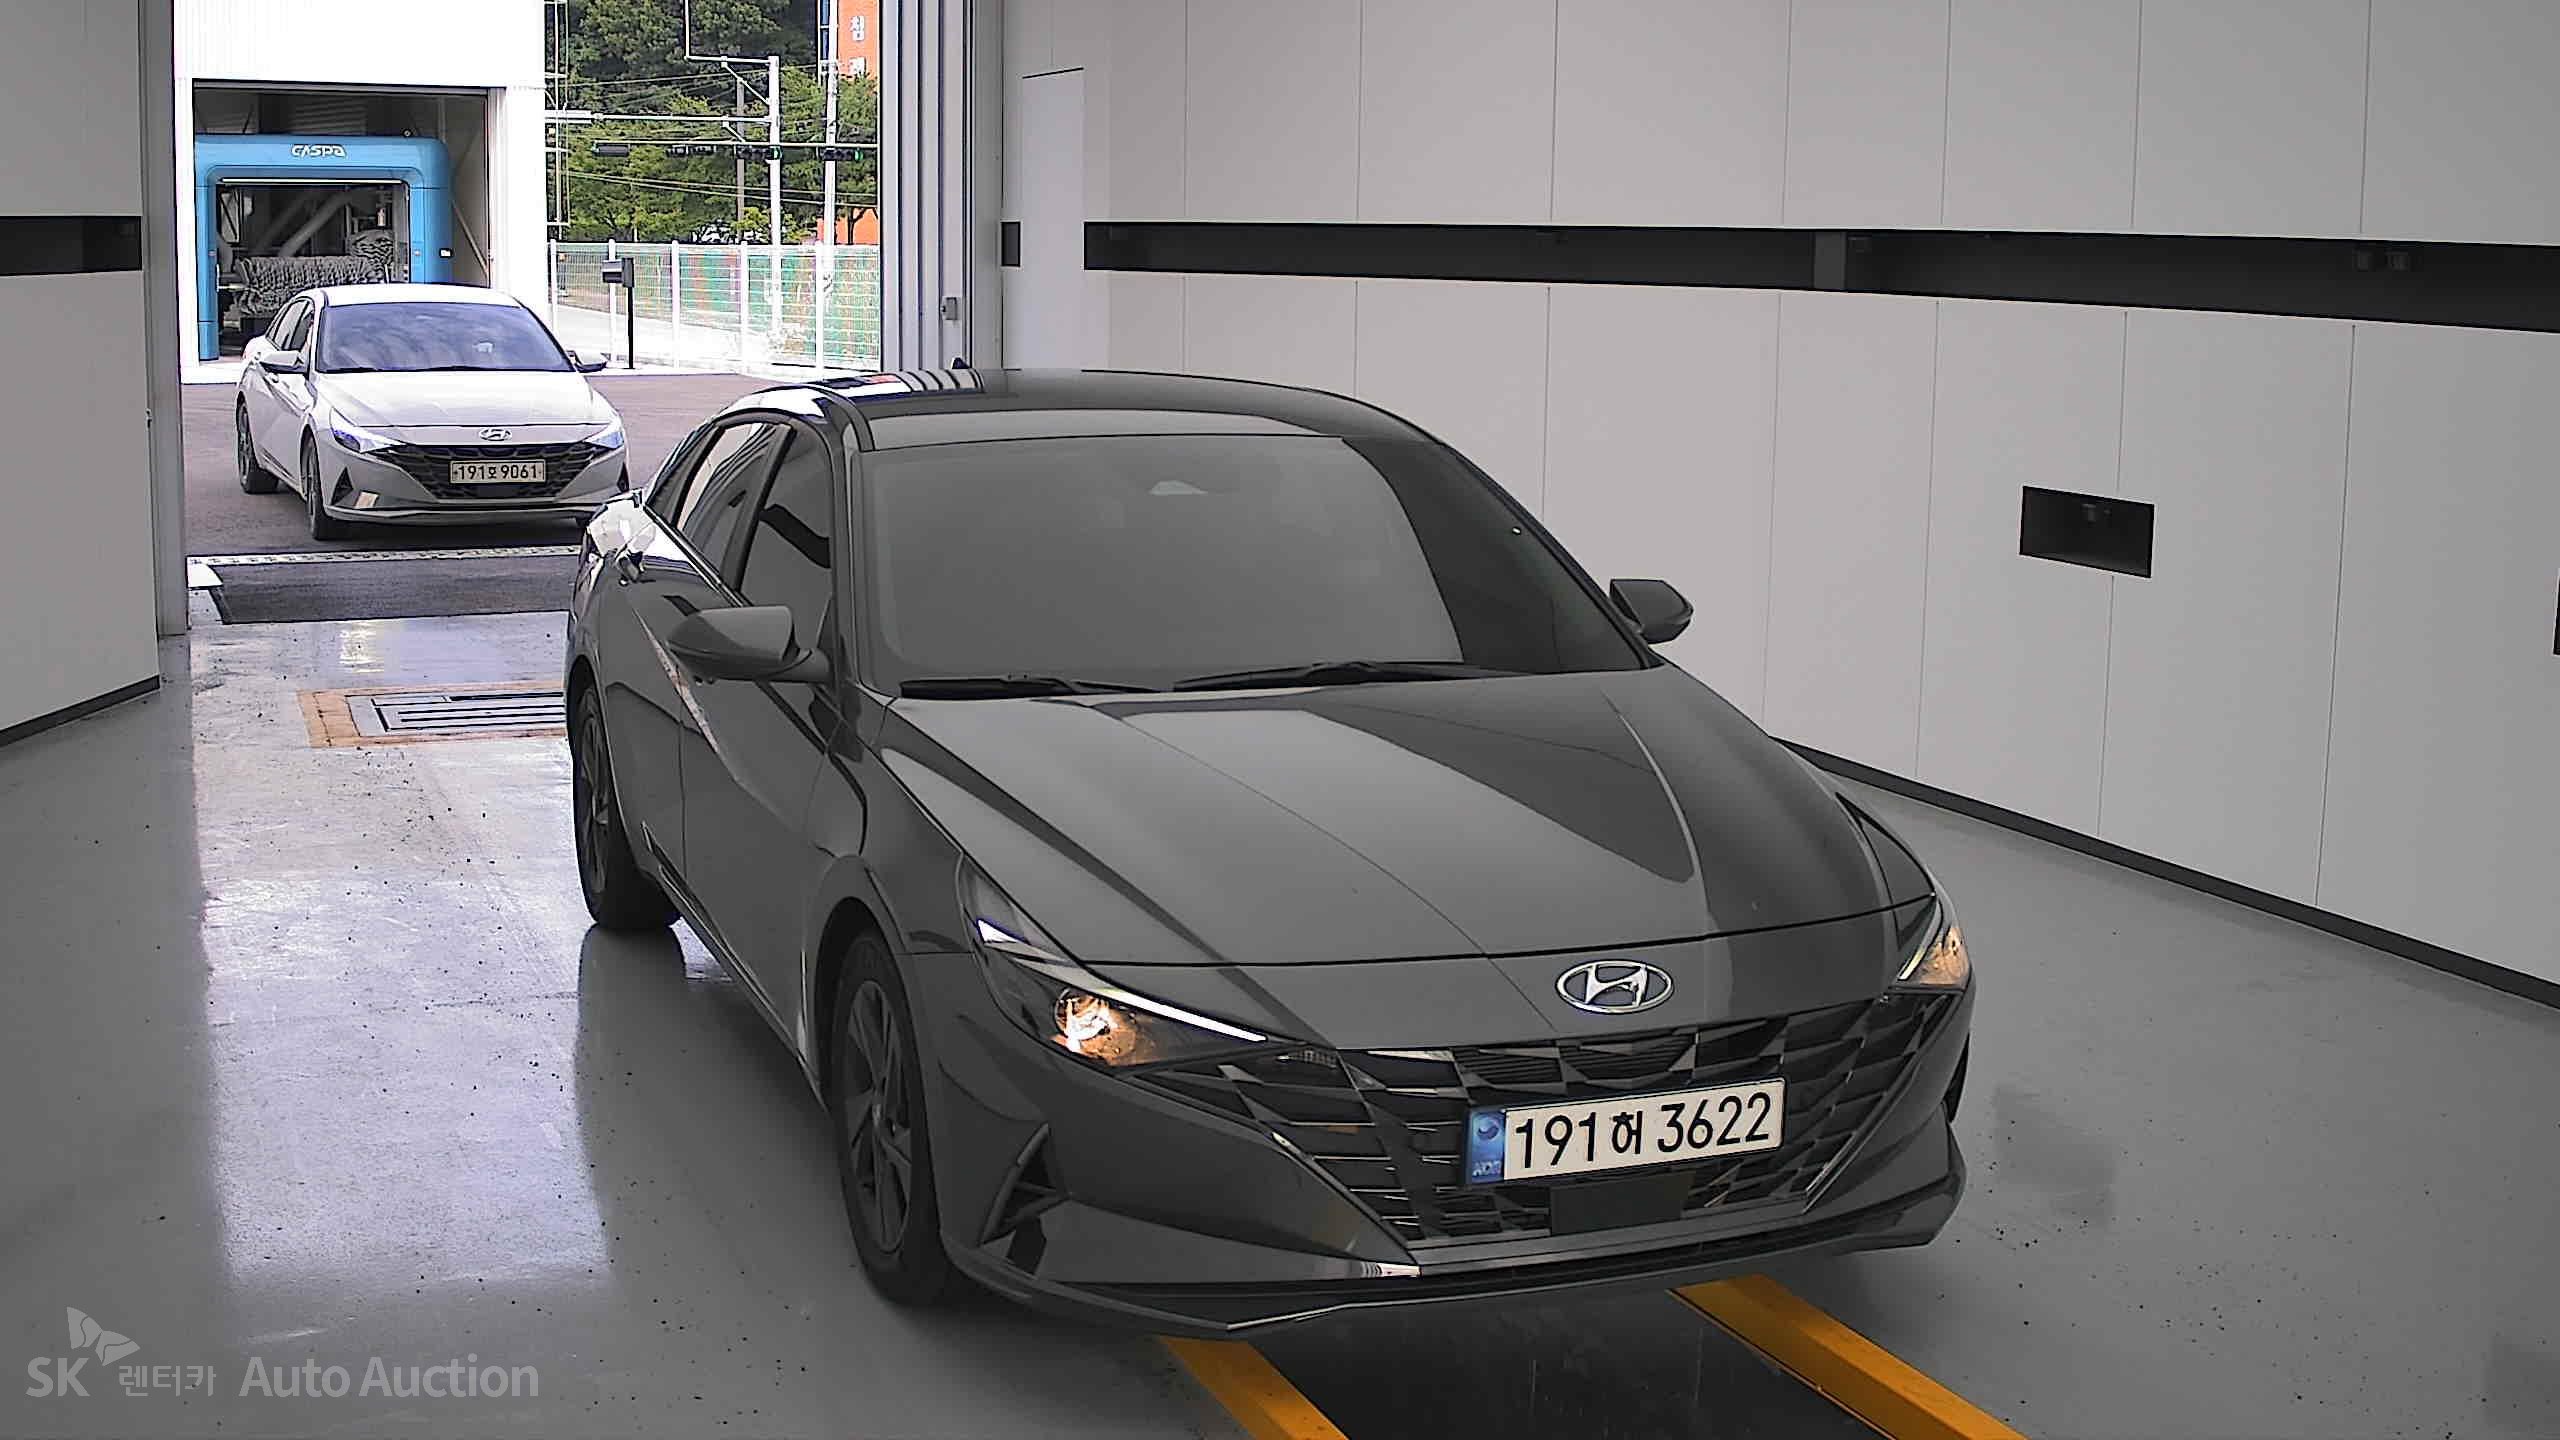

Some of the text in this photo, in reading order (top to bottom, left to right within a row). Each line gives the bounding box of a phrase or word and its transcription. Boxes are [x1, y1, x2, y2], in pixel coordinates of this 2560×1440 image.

[500, 464, 537, 479] 9061
[1515, 1092, 1771, 1169] 191허 3622
